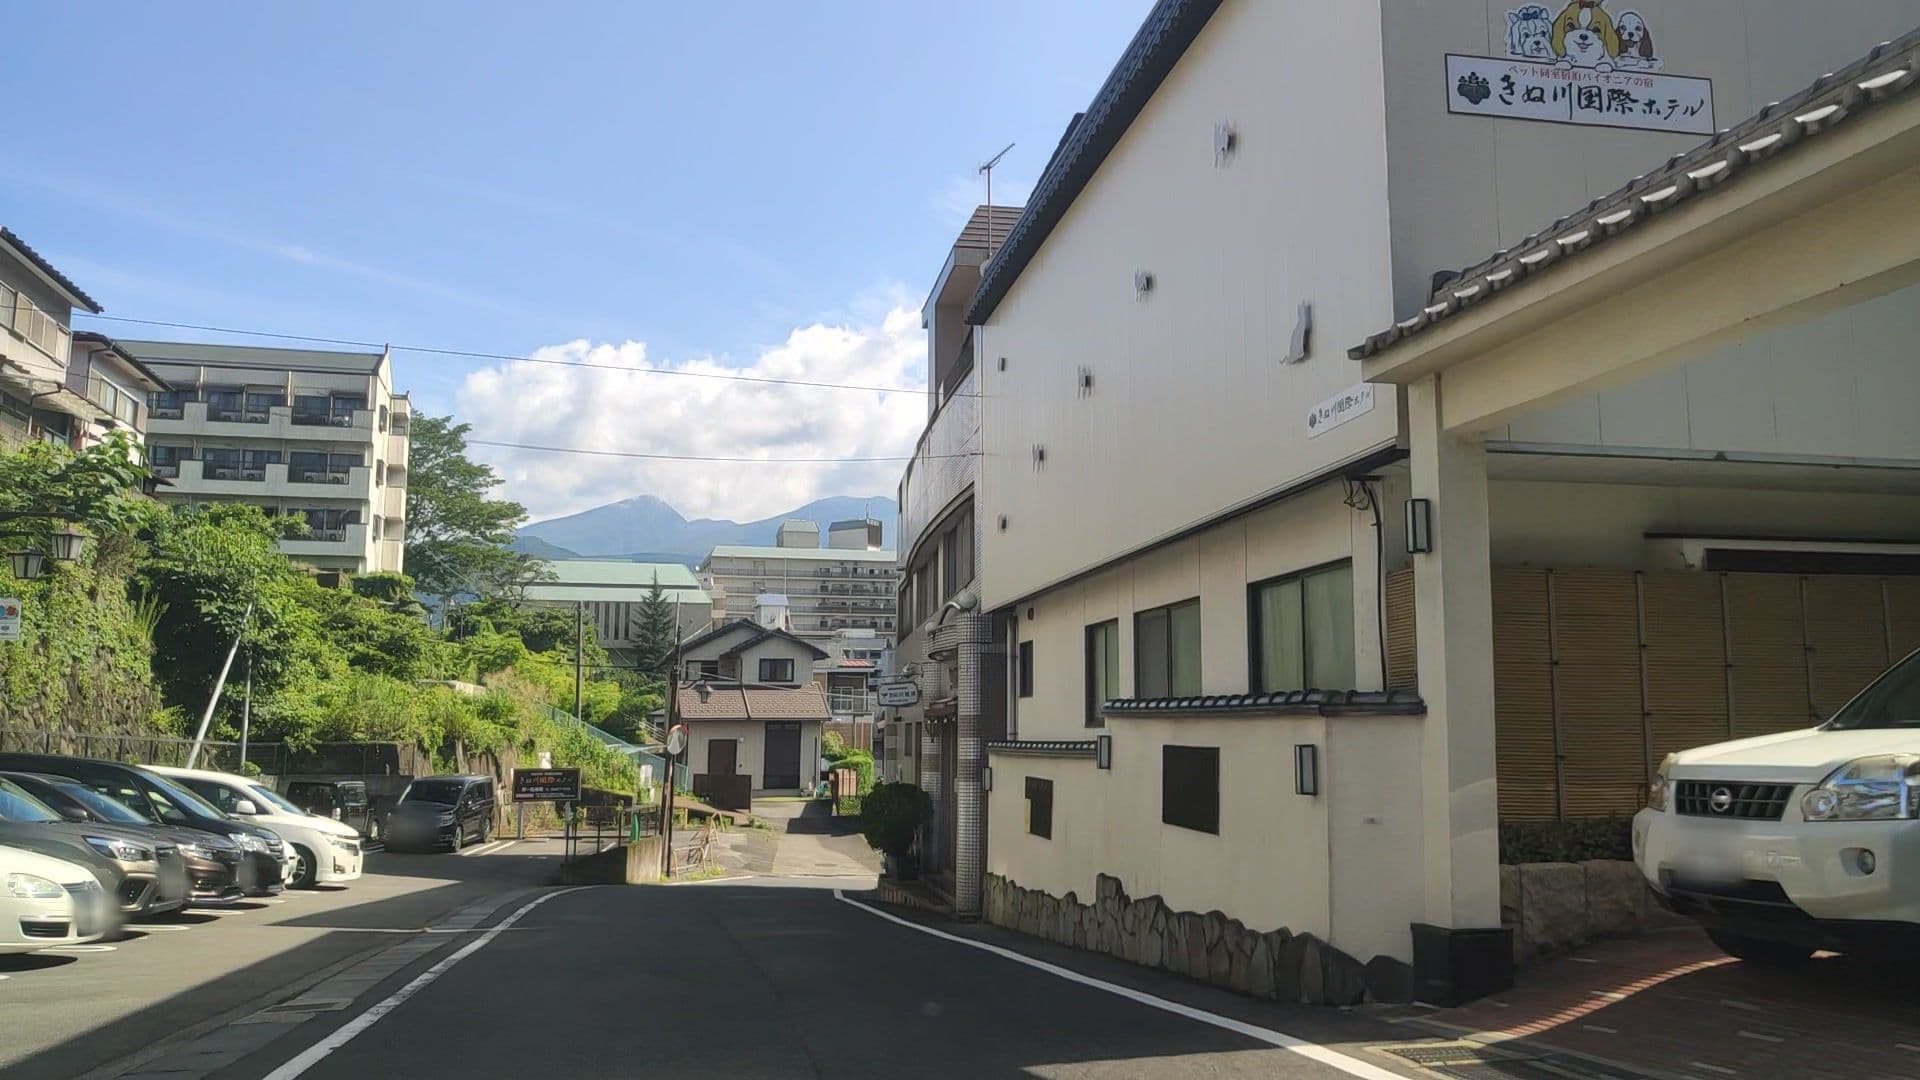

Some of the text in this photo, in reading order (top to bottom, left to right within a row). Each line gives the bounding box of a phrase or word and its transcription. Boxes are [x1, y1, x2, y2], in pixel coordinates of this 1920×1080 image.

[1498, 74, 1704, 120] きぬ川国際ホテル
